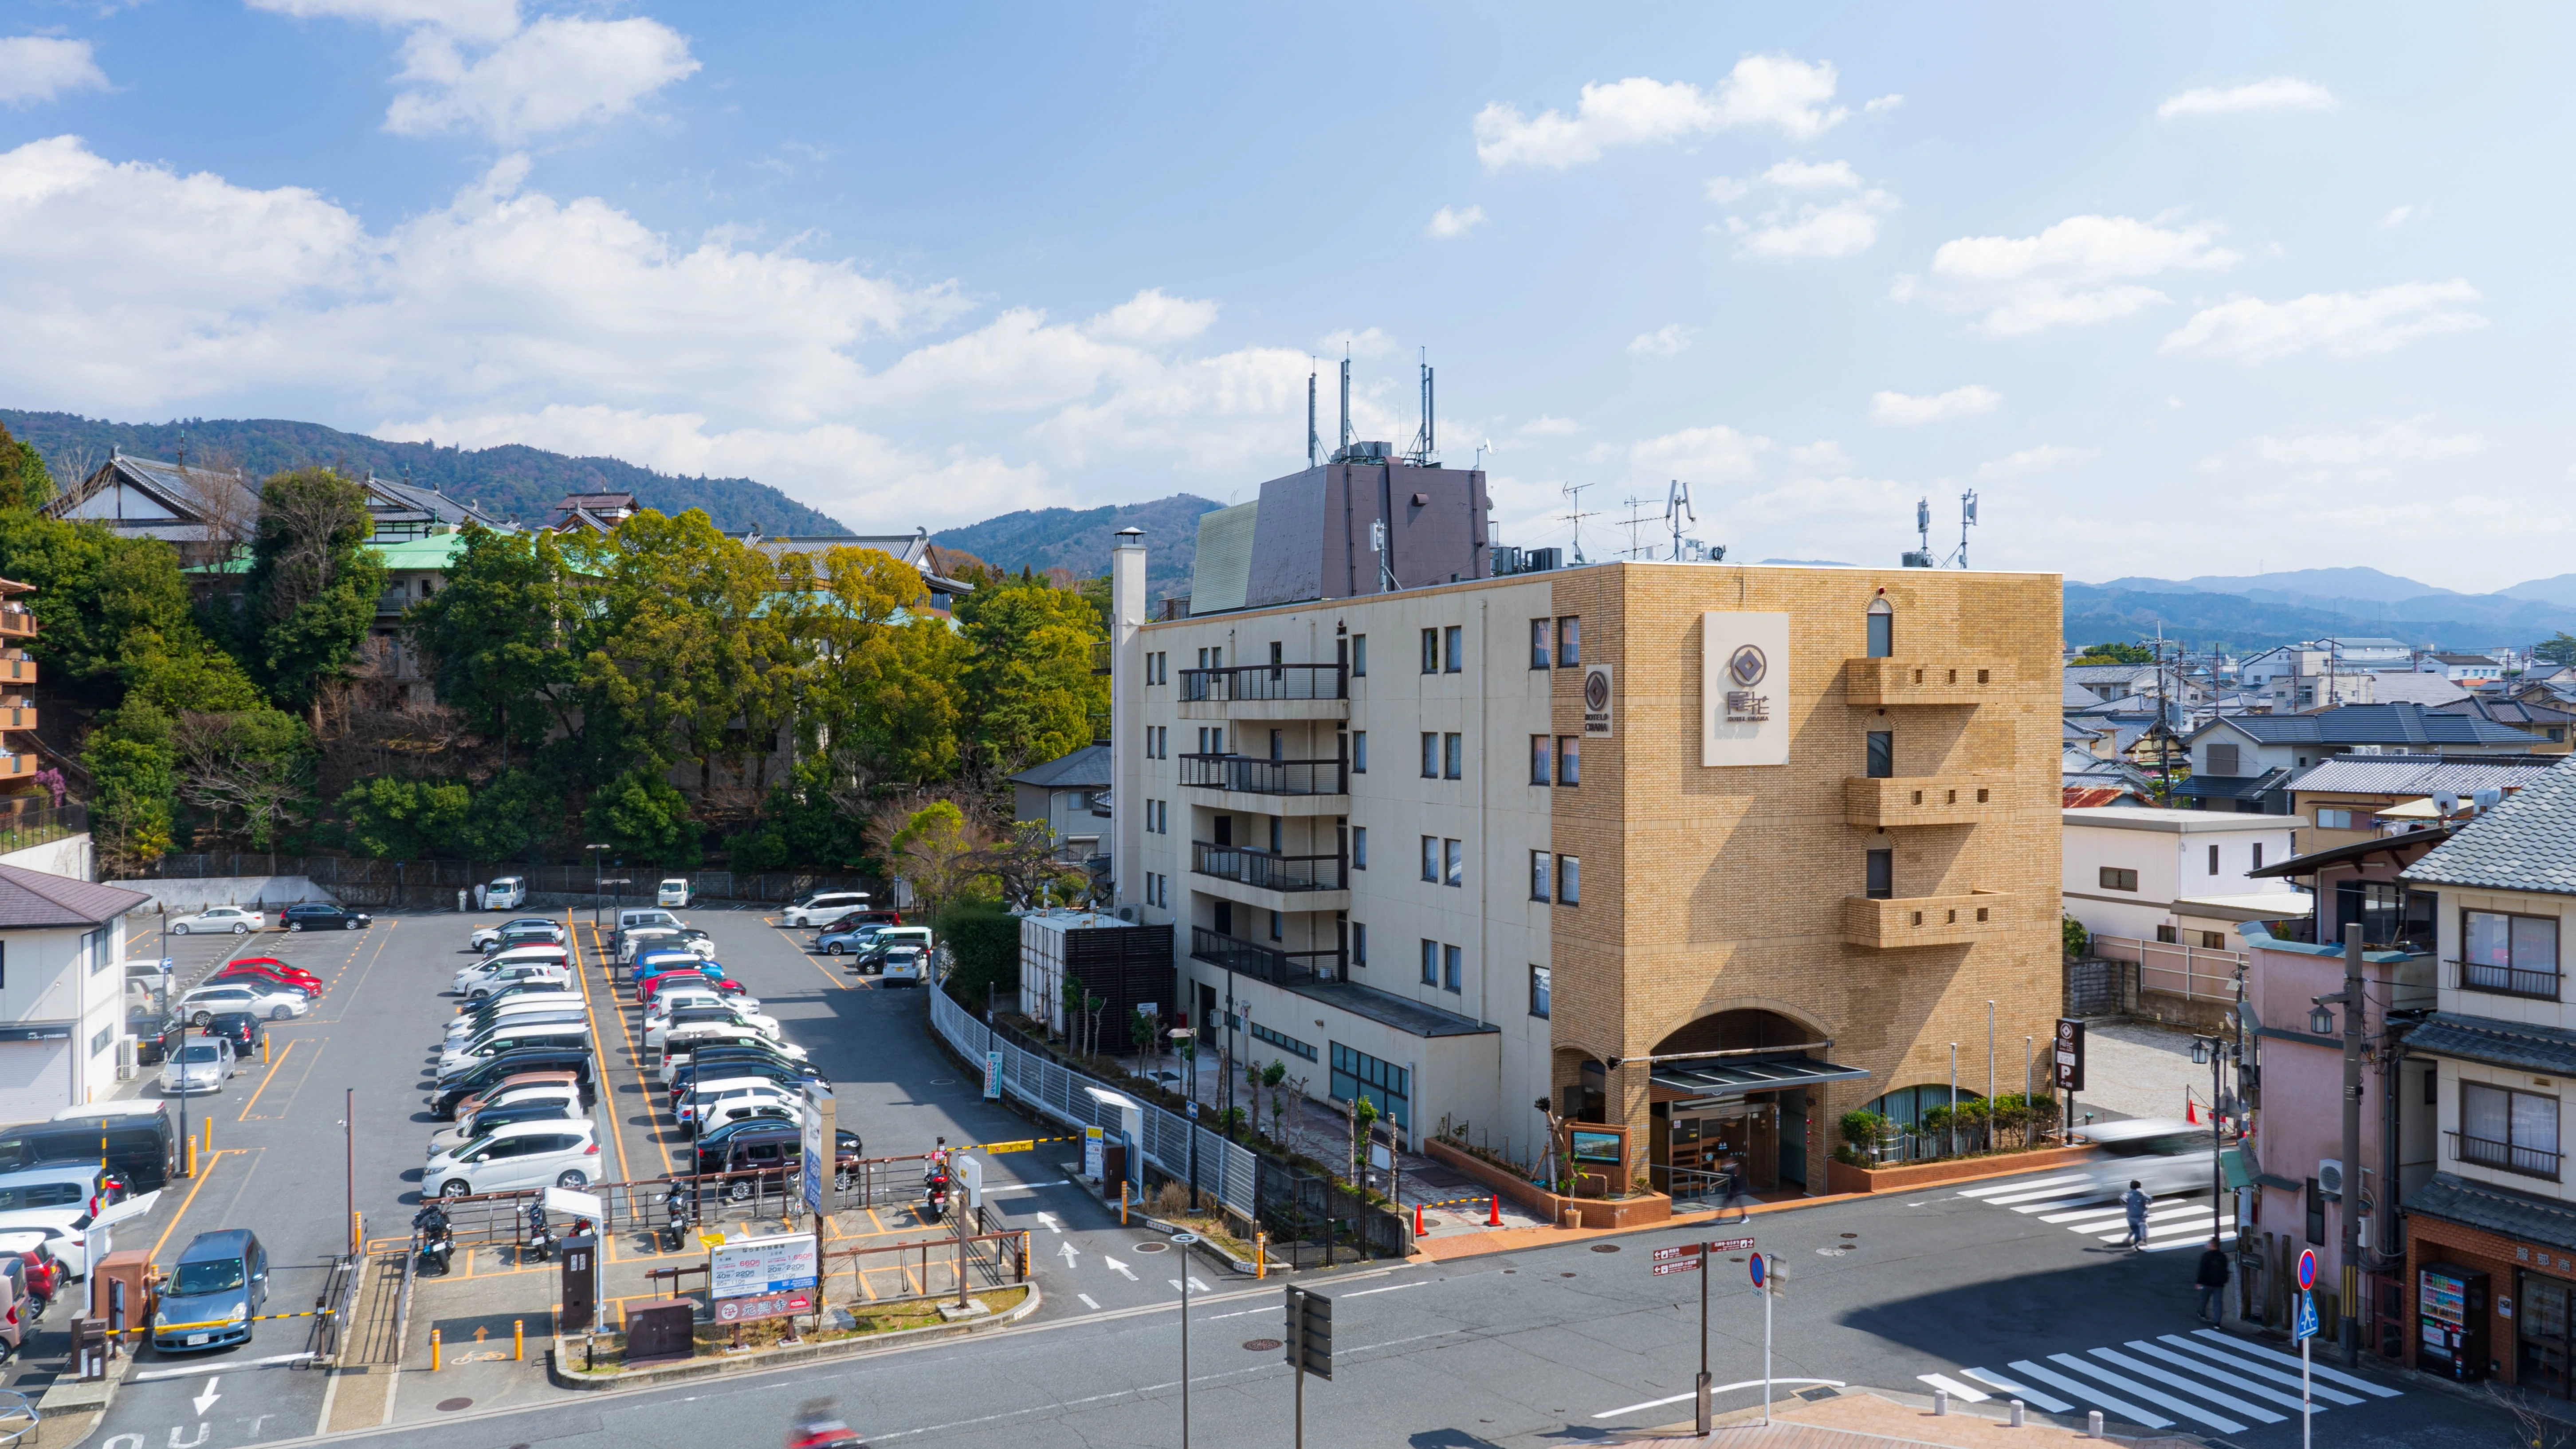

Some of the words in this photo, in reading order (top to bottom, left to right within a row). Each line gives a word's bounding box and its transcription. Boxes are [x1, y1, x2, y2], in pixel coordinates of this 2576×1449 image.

[2061, 1065, 2071, 1079] P
[2516, 1247, 2570, 1272] 服部商
[742, 1298, 787, 1316] 元興寺
